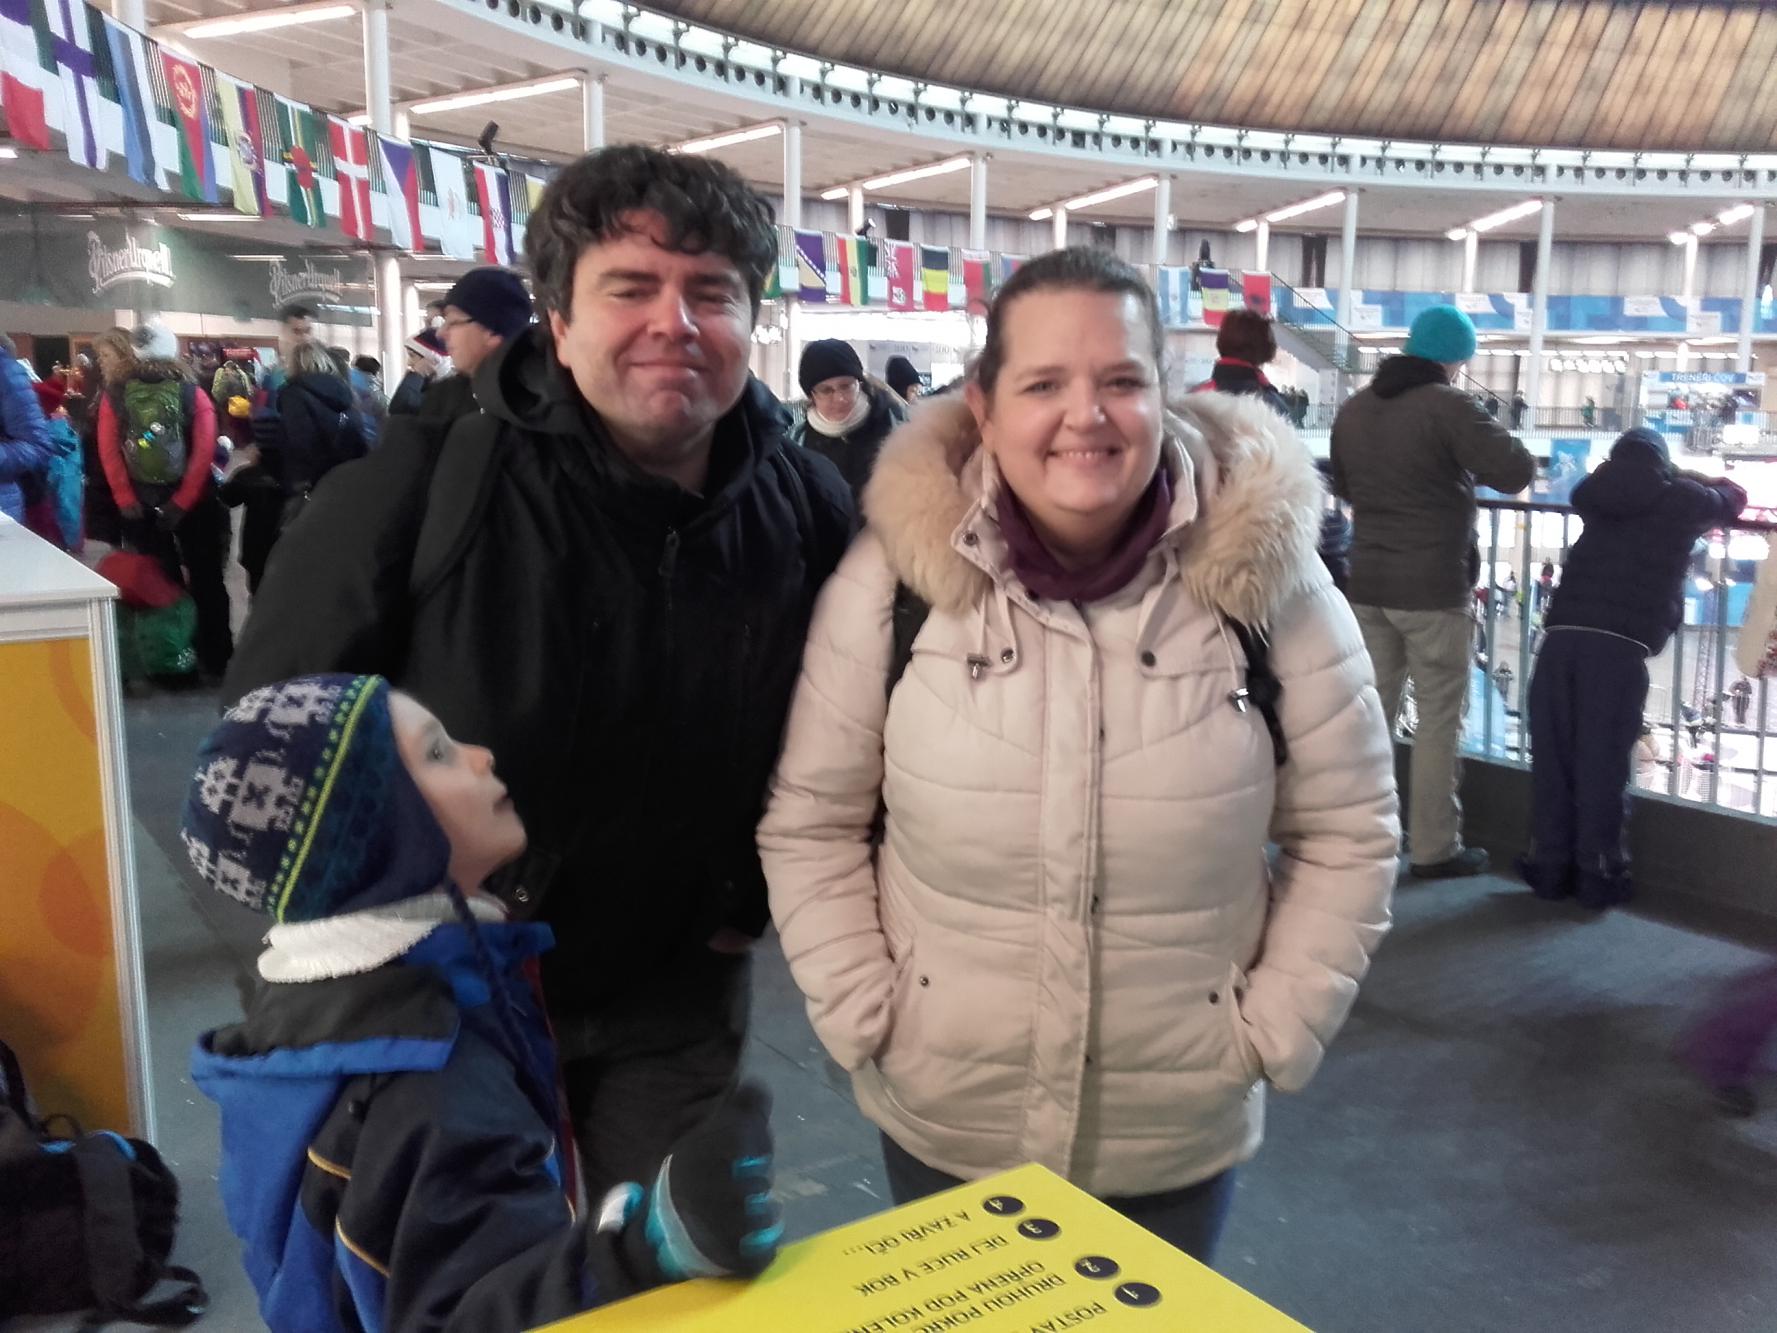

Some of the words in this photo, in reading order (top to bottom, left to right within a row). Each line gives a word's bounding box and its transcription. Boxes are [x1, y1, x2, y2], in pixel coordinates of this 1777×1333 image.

[986, 1198, 1004, 1212] 4
[961, 1210, 973, 1223] A
[1024, 1221, 1043, 1235] 3
[971, 1234, 1011, 1256] DEJ
[917, 1249, 974, 1276] RUCE
[1079, 1257, 1101, 1274] 2
[902, 1267, 918, 1282] V
[854, 1273, 901, 1298] BOK
[983, 1272, 1067, 1313] DRUHOU
[1121, 1286, 1140, 1301] 1
[924, 1288, 971, 1313] POD
